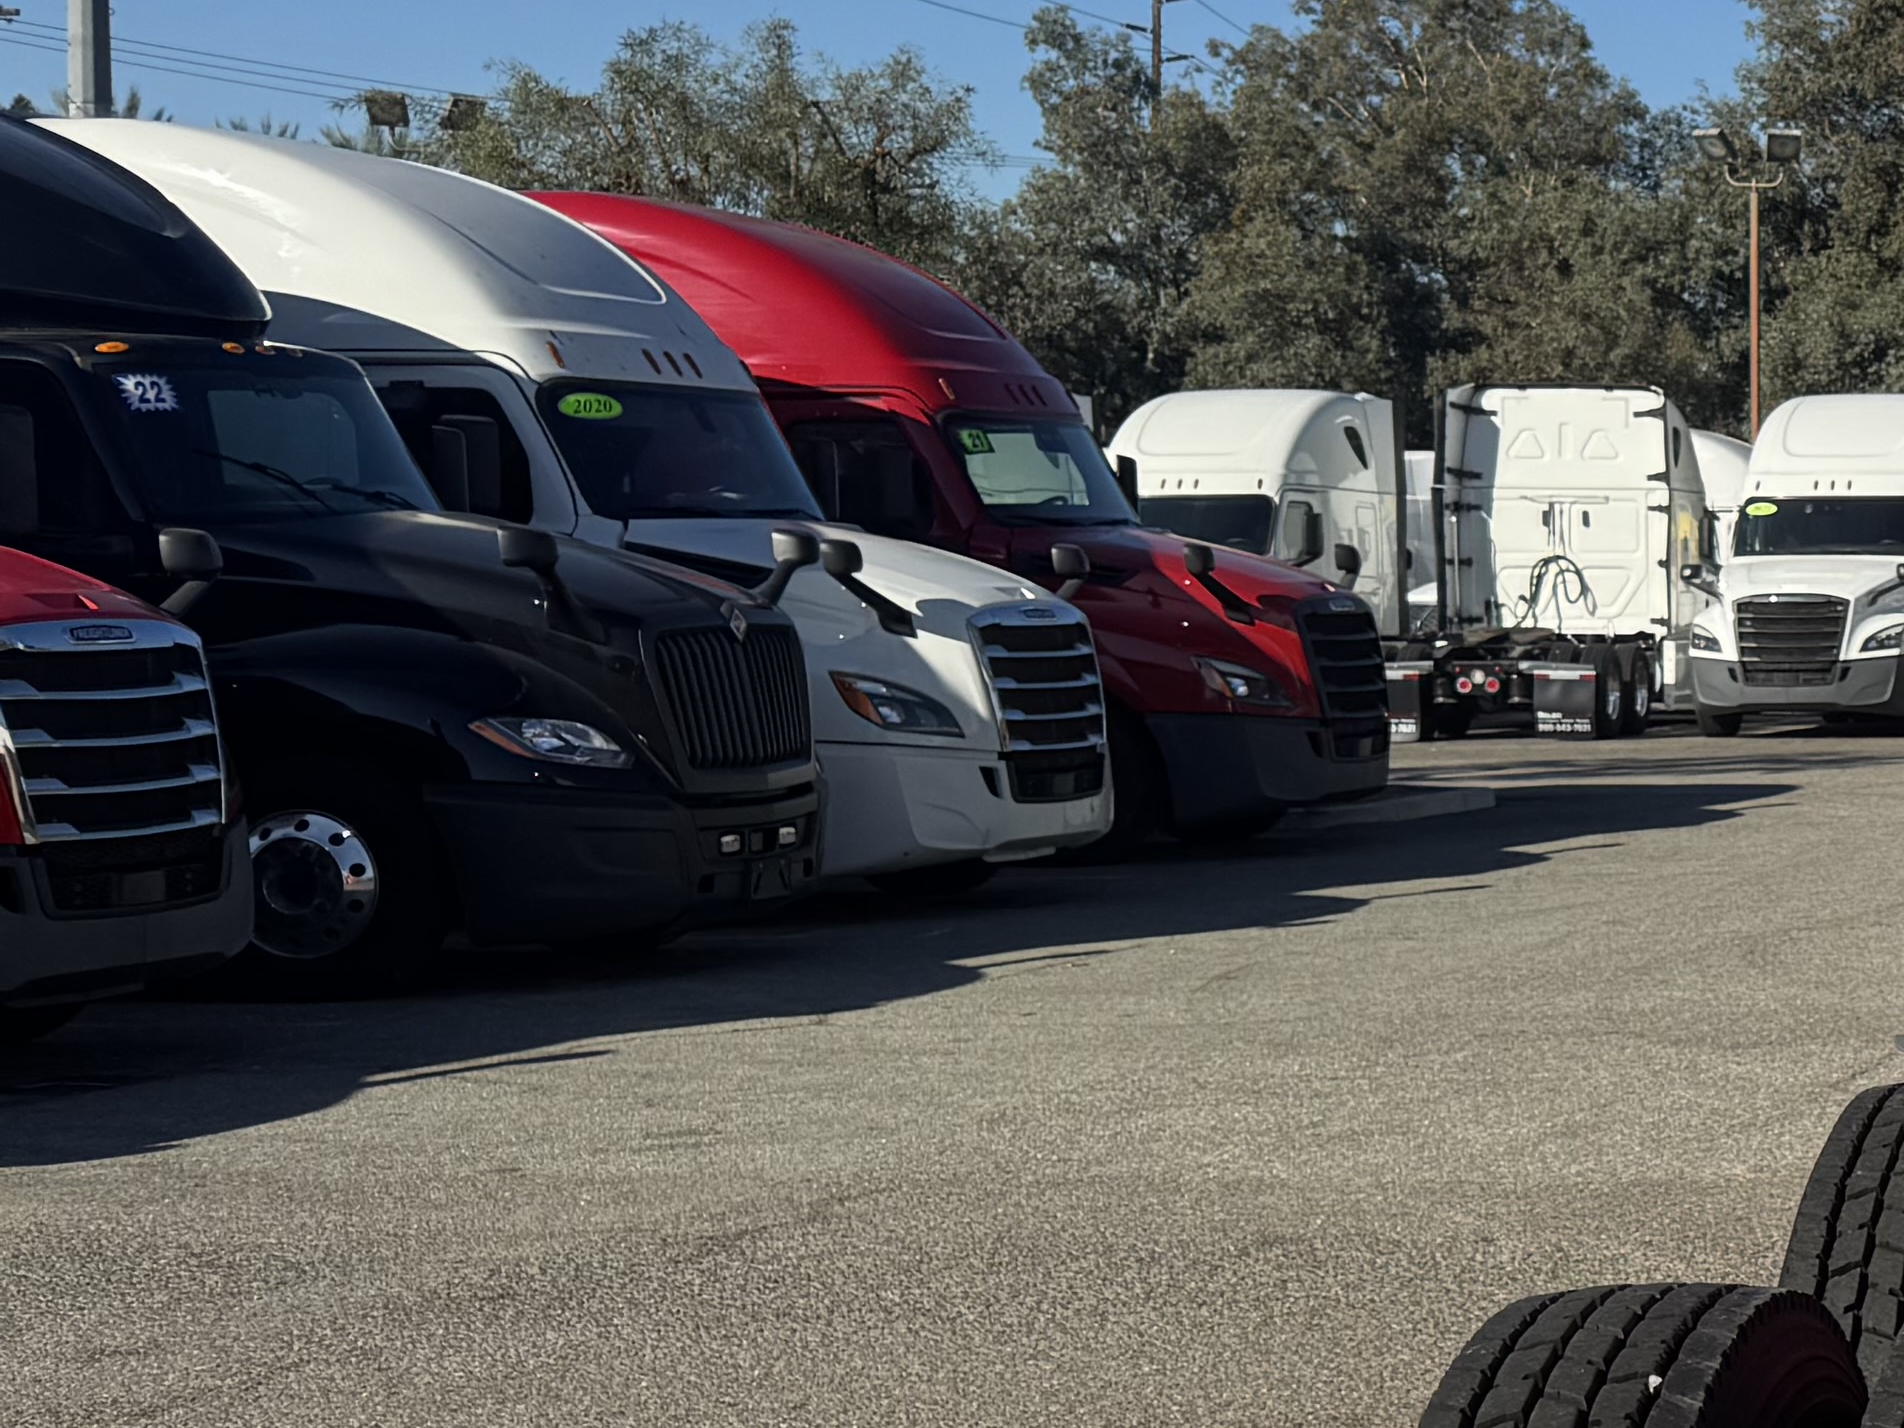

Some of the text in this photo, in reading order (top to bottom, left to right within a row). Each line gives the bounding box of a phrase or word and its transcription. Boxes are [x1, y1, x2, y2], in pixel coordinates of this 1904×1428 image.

[134, 380, 167, 404] 22
[573, 398, 613, 414] 2020
[968, 431, 985, 448] 21
